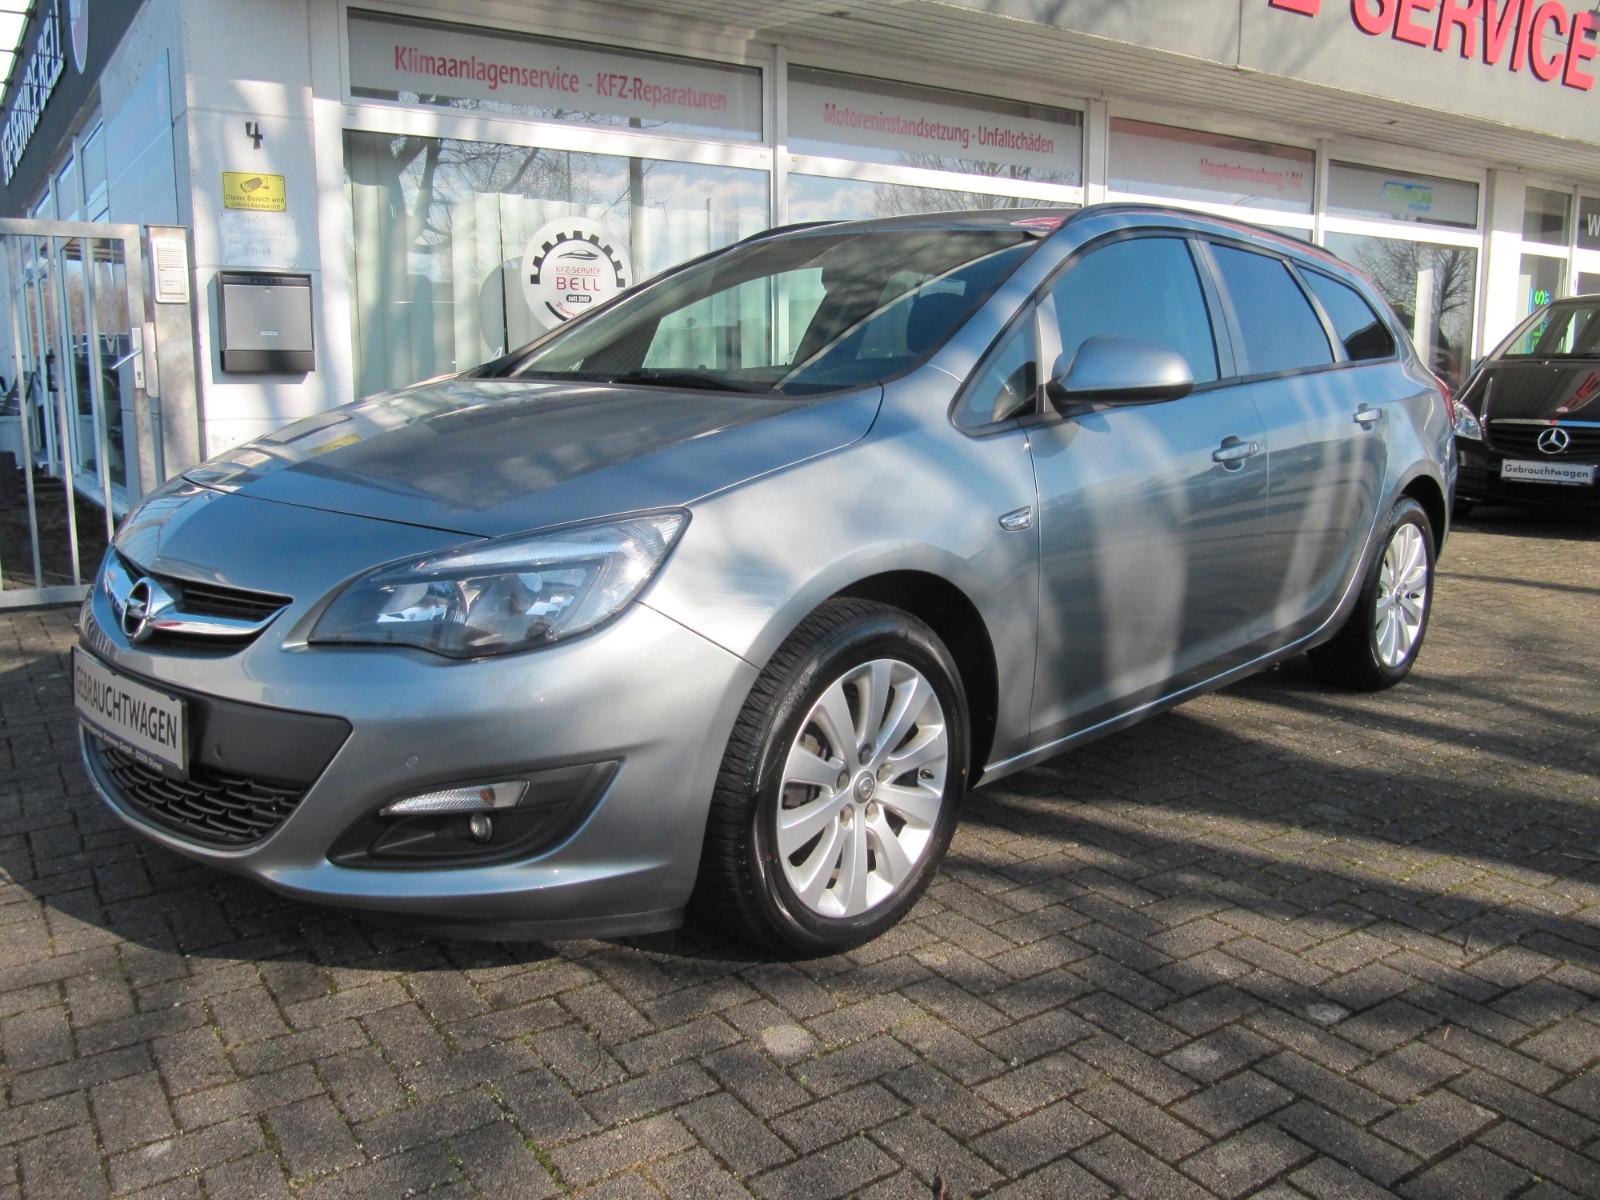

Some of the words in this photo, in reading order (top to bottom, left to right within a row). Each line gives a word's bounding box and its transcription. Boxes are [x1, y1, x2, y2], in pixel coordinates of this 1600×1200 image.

[394, 45, 579, 92] Klimaanlagenservice
[597, 73, 728, 112] KFZ-Reparaturen
[245, 121, 263, 149] 4
[824, 102, 969, 149] Motoreninstandsetzung
[978, 126, 1055, 154] Unfallschäden
[555, 266, 600, 274] KFZ-SERVICE
[556, 277, 601, 291] BELL
[1504, 464, 1589, 479] Gebrauchtwagen
[76, 665, 177, 749] GEBRAUCHTWAGEN
